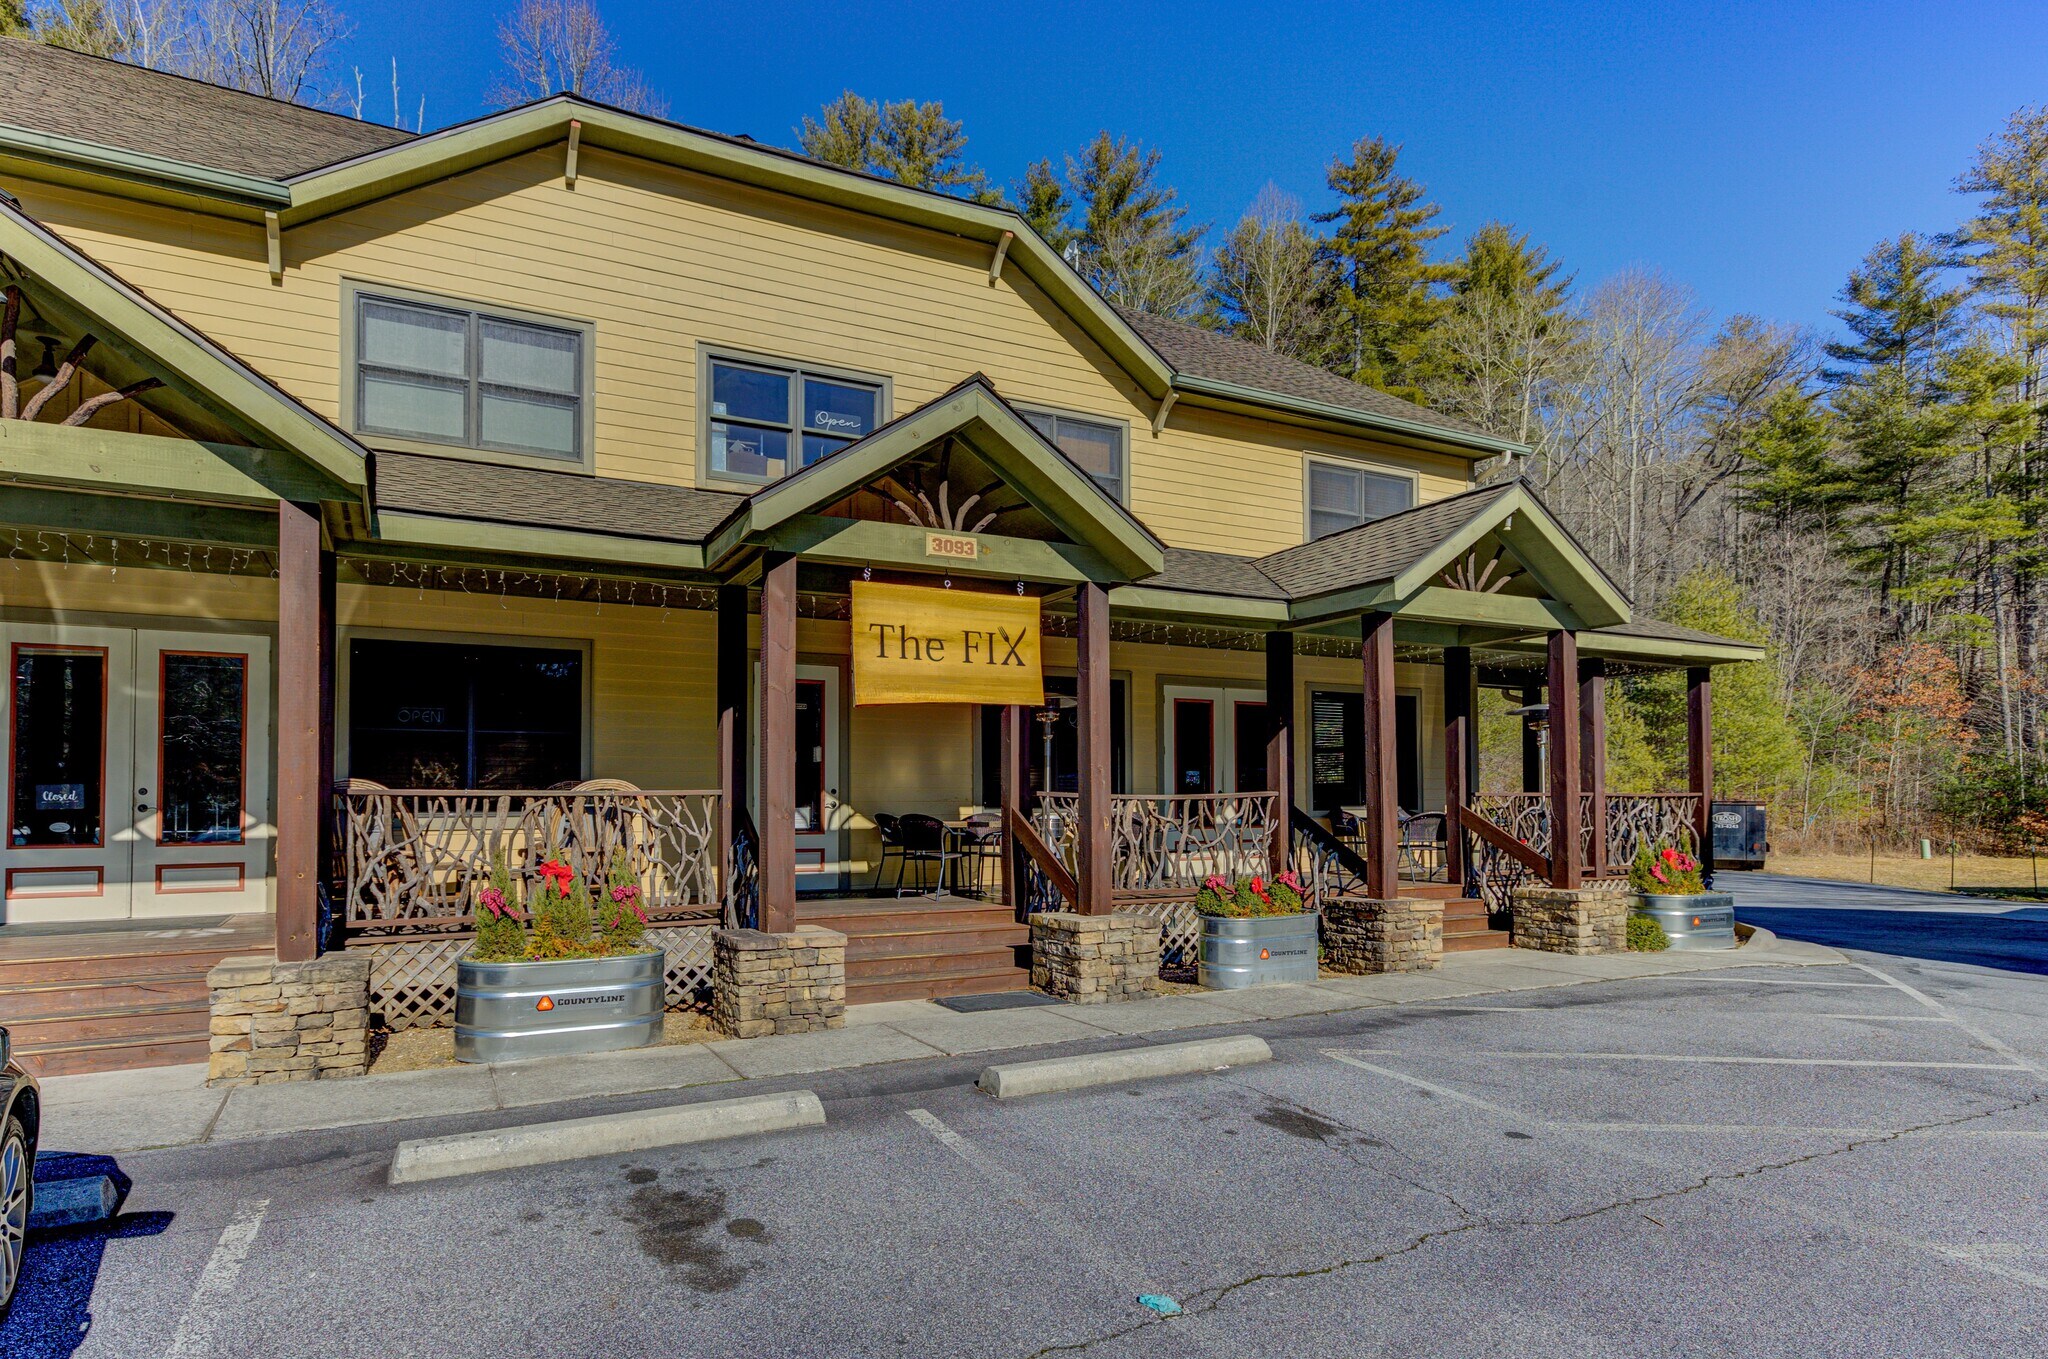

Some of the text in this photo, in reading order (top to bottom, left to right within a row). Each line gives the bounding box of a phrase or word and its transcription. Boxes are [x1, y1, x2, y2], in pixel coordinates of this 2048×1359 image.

[815, 411, 861, 431] Open
[932, 538, 975, 556] 3093
[868, 623, 1027, 667] The FIX
[398, 709, 441, 723] OPEN
[42, 790, 78, 802] Closed
[557, 995, 625, 1006] COUNTYLINE
